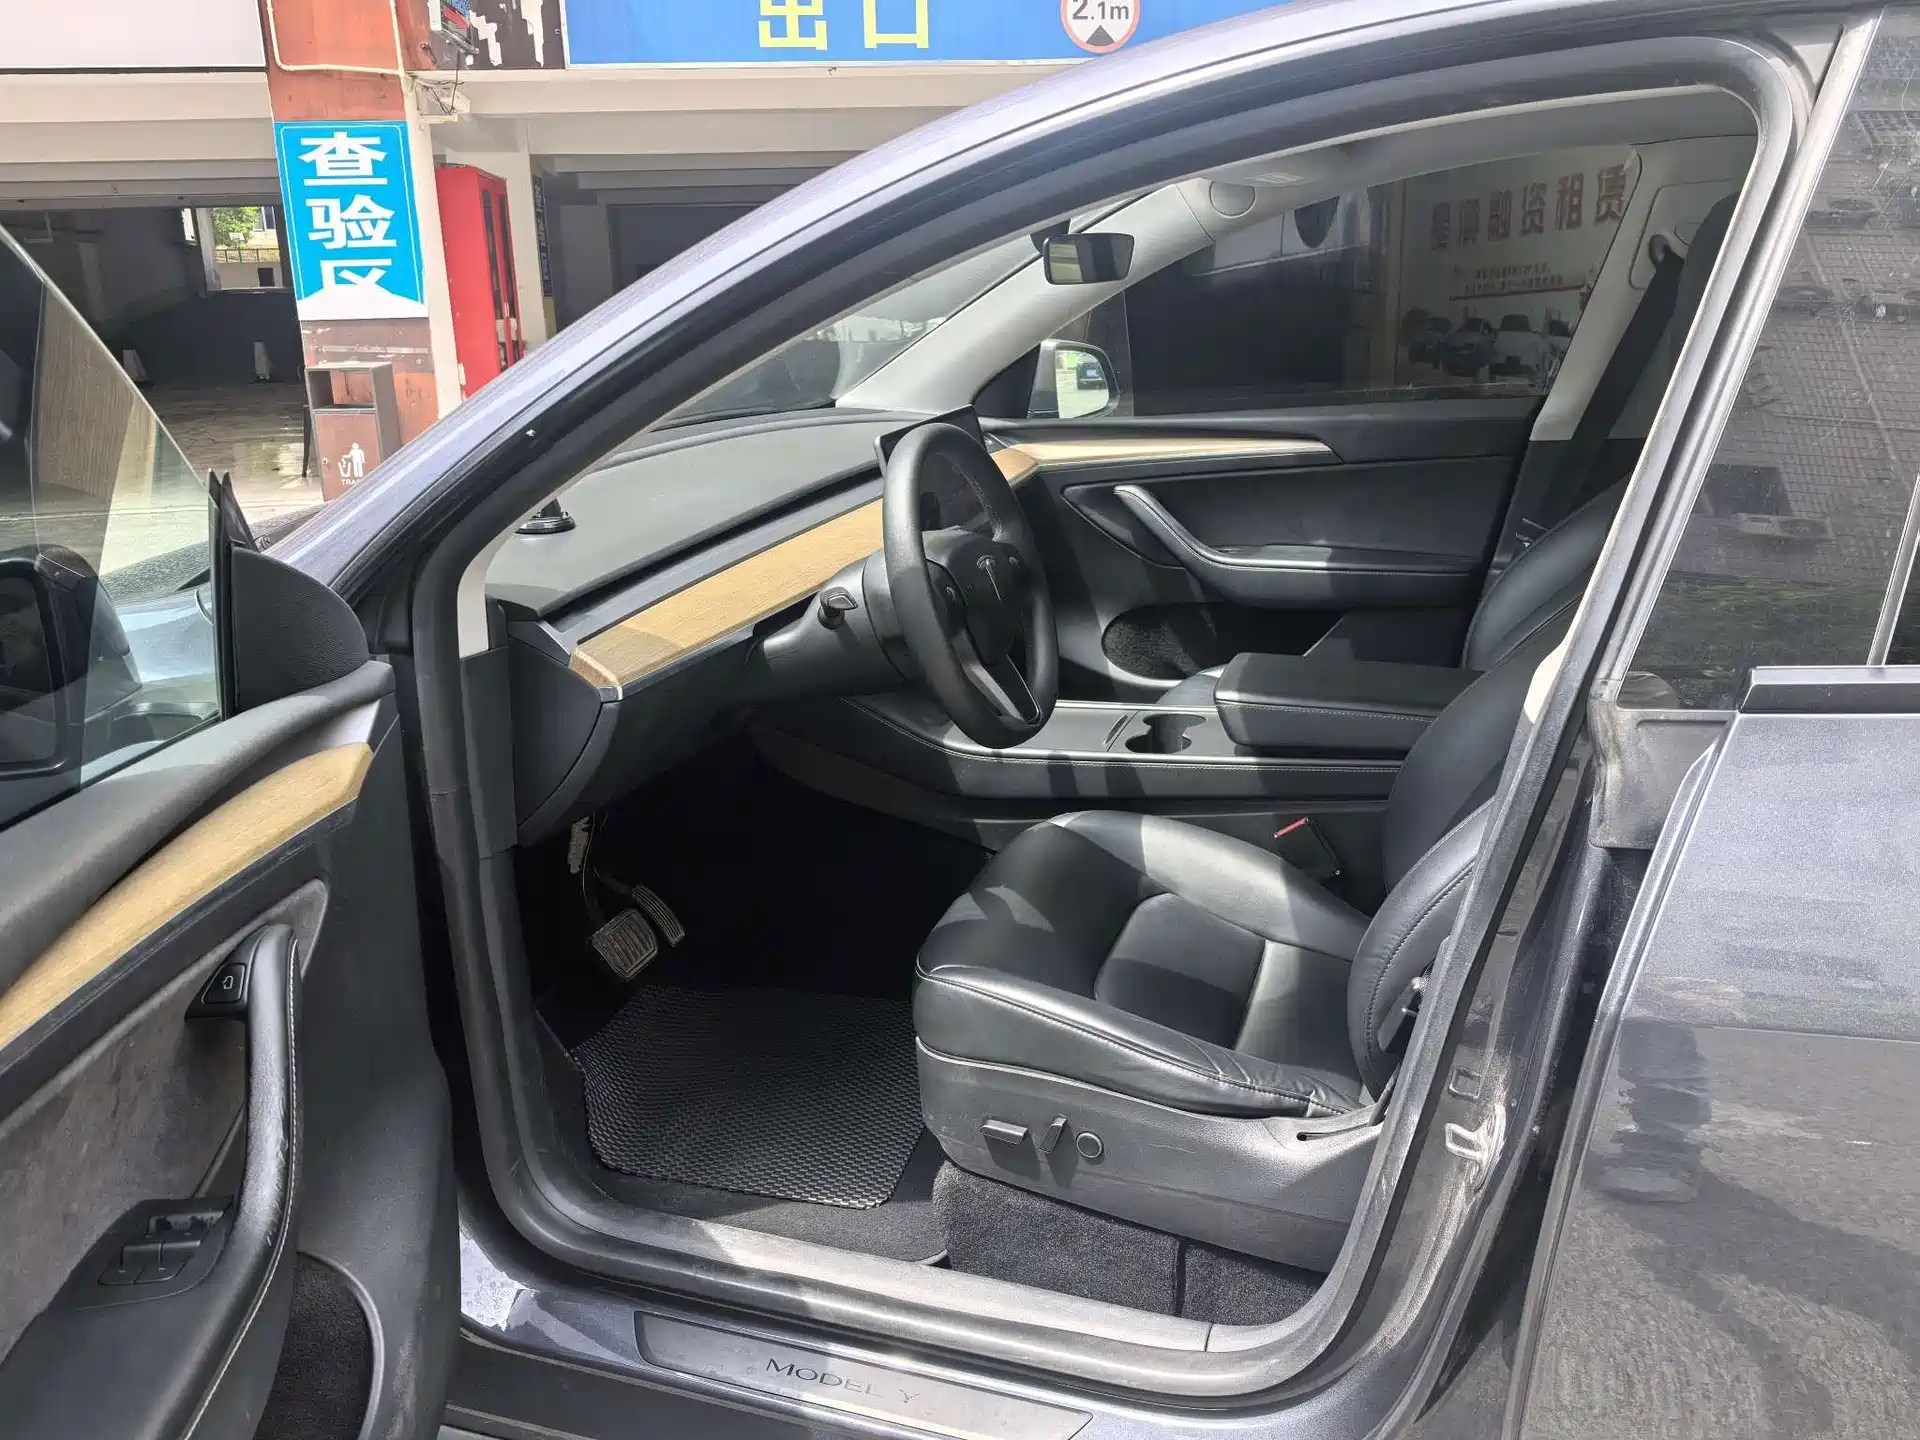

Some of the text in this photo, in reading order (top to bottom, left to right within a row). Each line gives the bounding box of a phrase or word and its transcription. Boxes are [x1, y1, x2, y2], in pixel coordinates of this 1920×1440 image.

[758, 0, 929, 50] 出口
[1072, 0, 1129, 20] 2.1m
[298, 131, 398, 292] 查验区
[766, 1358, 921, 1404] MODEL Y
